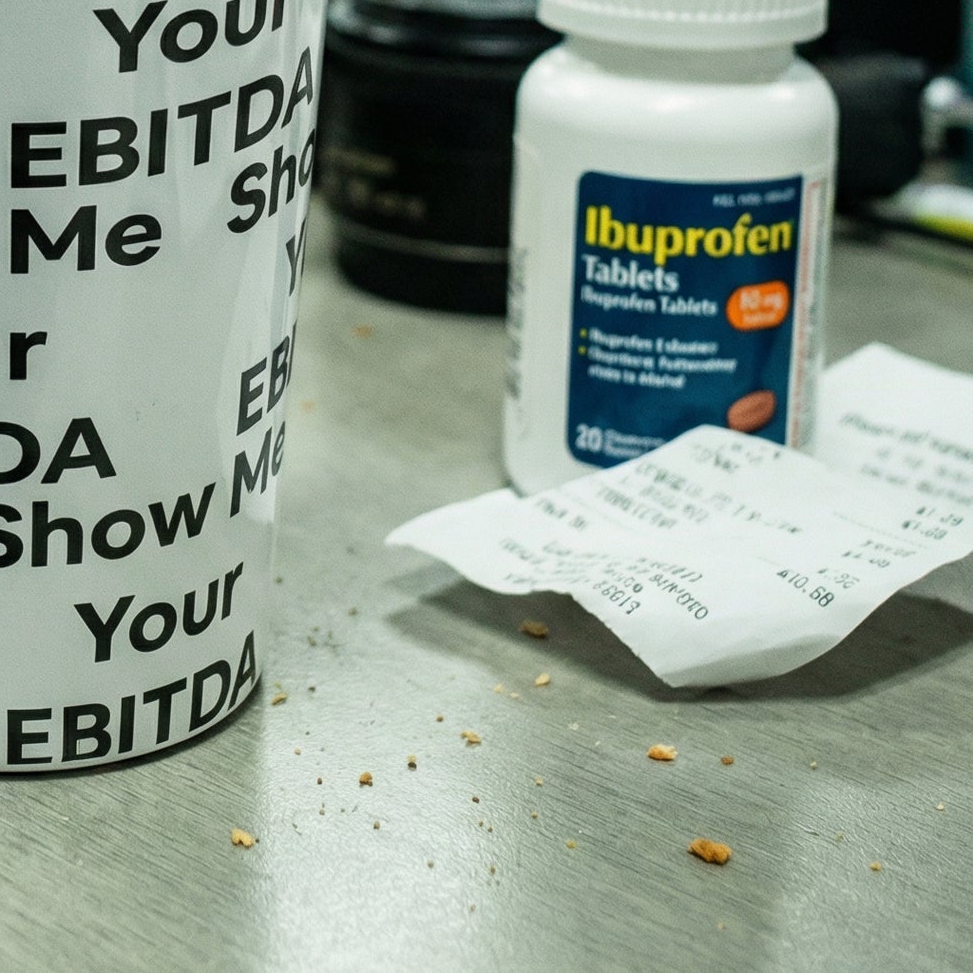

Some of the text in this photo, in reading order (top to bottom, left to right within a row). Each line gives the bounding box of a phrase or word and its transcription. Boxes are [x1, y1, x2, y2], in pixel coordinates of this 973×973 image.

[10, 46, 314, 189] EBITDA
[10, 205, 162, 275] Me
[582, 253, 679, 293] Tablets
[584, 205, 793, 266] Ibuprofen
[229, 420, 287, 518] Me
[575, 424, 603, 452] 20
[73, 561, 244, 663] Your
[6, 630, 257, 765] EBITDA
